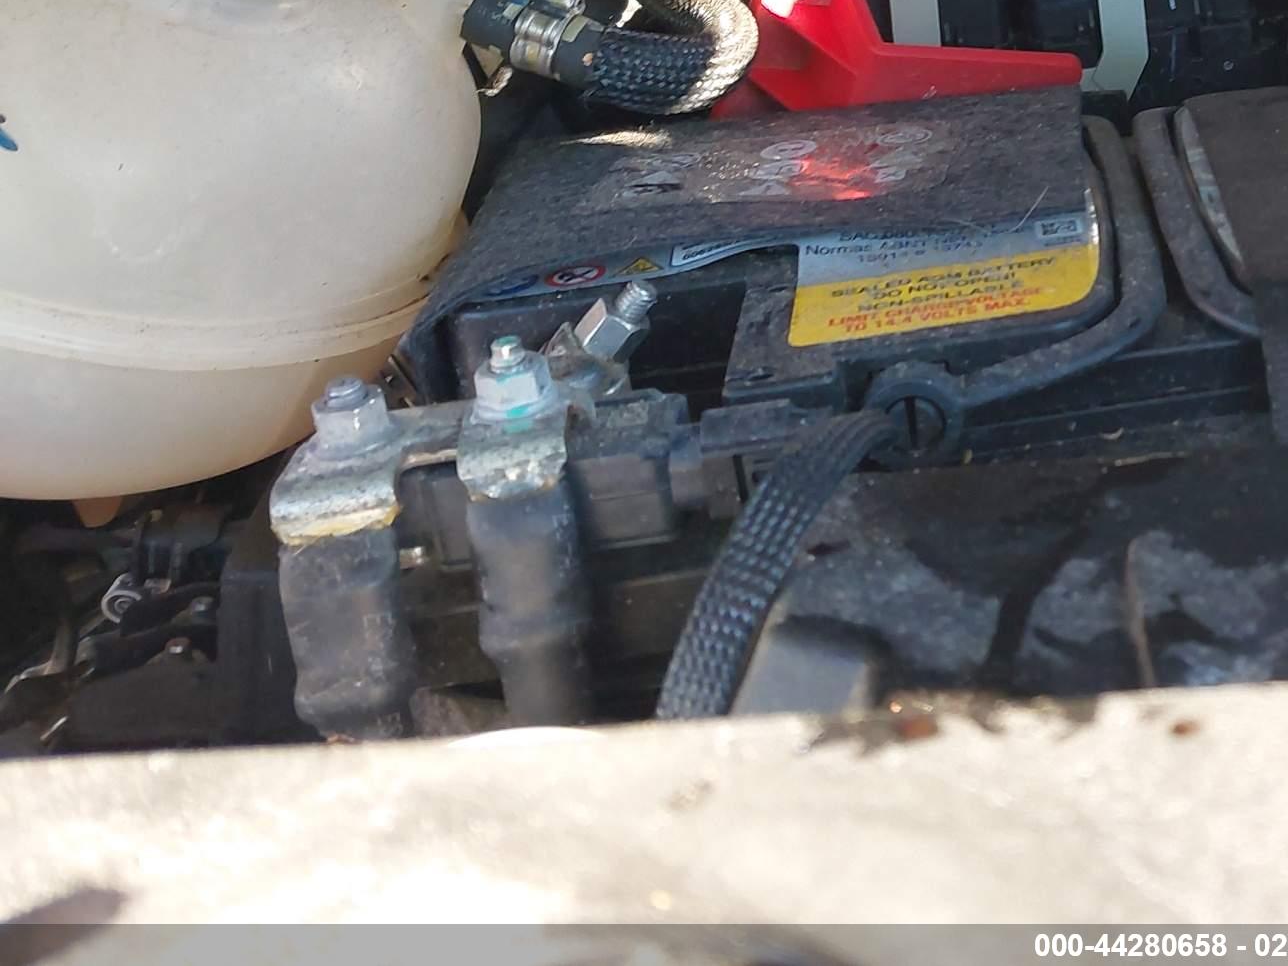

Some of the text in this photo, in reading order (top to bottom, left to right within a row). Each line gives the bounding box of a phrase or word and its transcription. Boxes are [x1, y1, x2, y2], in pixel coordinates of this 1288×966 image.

[805, 240, 873, 256] Normas
[831, 256, 1056, 298] SEALED AGM BATTERY
[872, 287, 902, 301] DO
[908, 280, 949, 296] NOT
[827, 286, 1043, 328] LIMIT CHARGE VOLTAGE
[856, 279, 1026, 313] NON-SPILLABLE
[844, 321, 868, 333] TO
[919, 305, 978, 322] VOLTS
